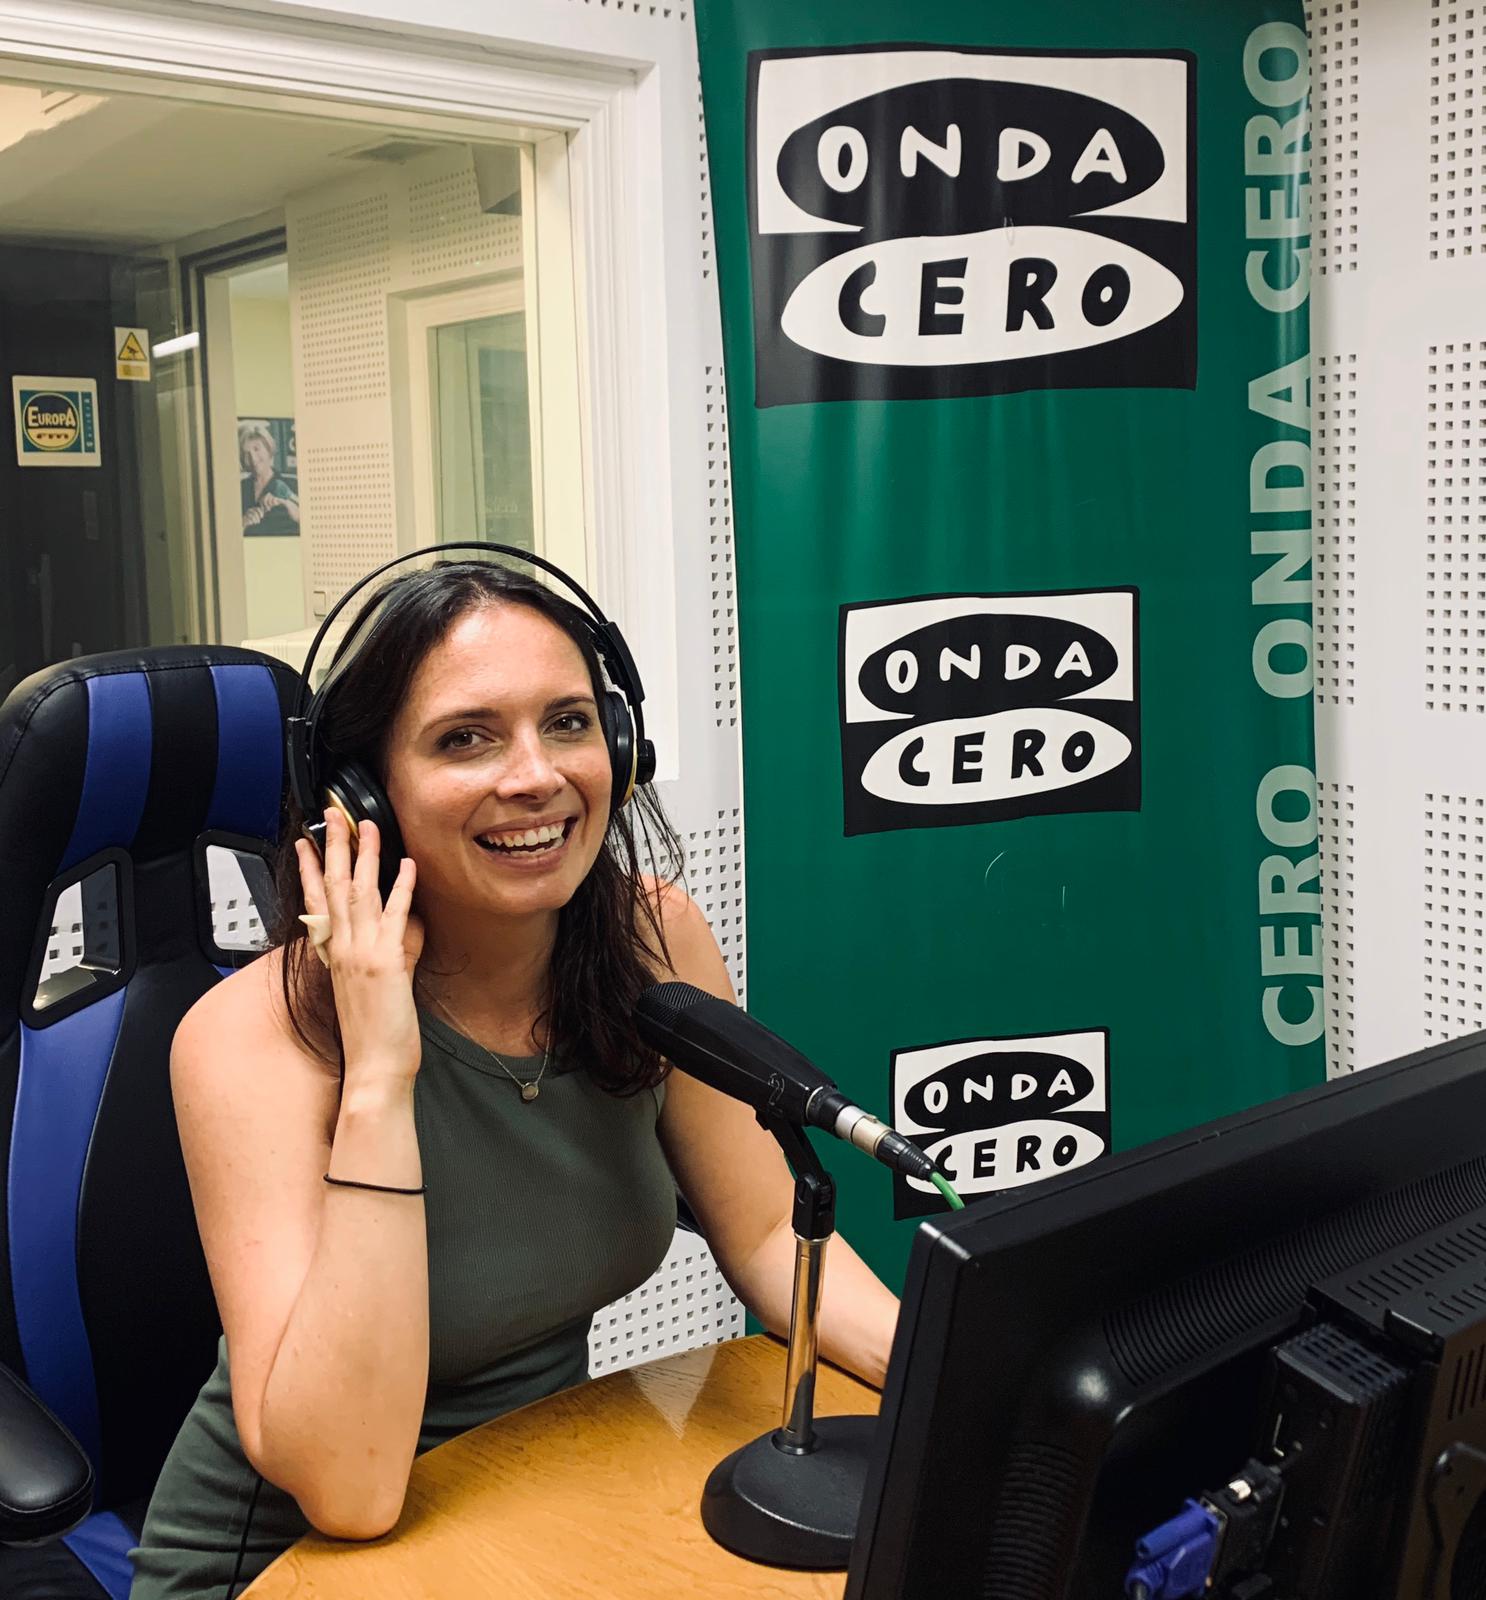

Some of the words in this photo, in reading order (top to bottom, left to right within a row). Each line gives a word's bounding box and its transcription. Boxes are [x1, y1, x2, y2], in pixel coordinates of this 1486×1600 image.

[817, 124, 1127, 193] ONDA
[1243, 22, 1311, 313] CERO
[838, 257, 1130, 337] CERO
[28, 406, 76, 427] EUROPA
[1249, 352, 1314, 698] ONDA
[885, 641, 1092, 693] ONDA
[898, 728, 1095, 787] CERO
[1256, 765, 1325, 1046] CERO
[923, 1069, 1075, 1114] ONDA
[934, 1135, 1077, 1181] CERO
